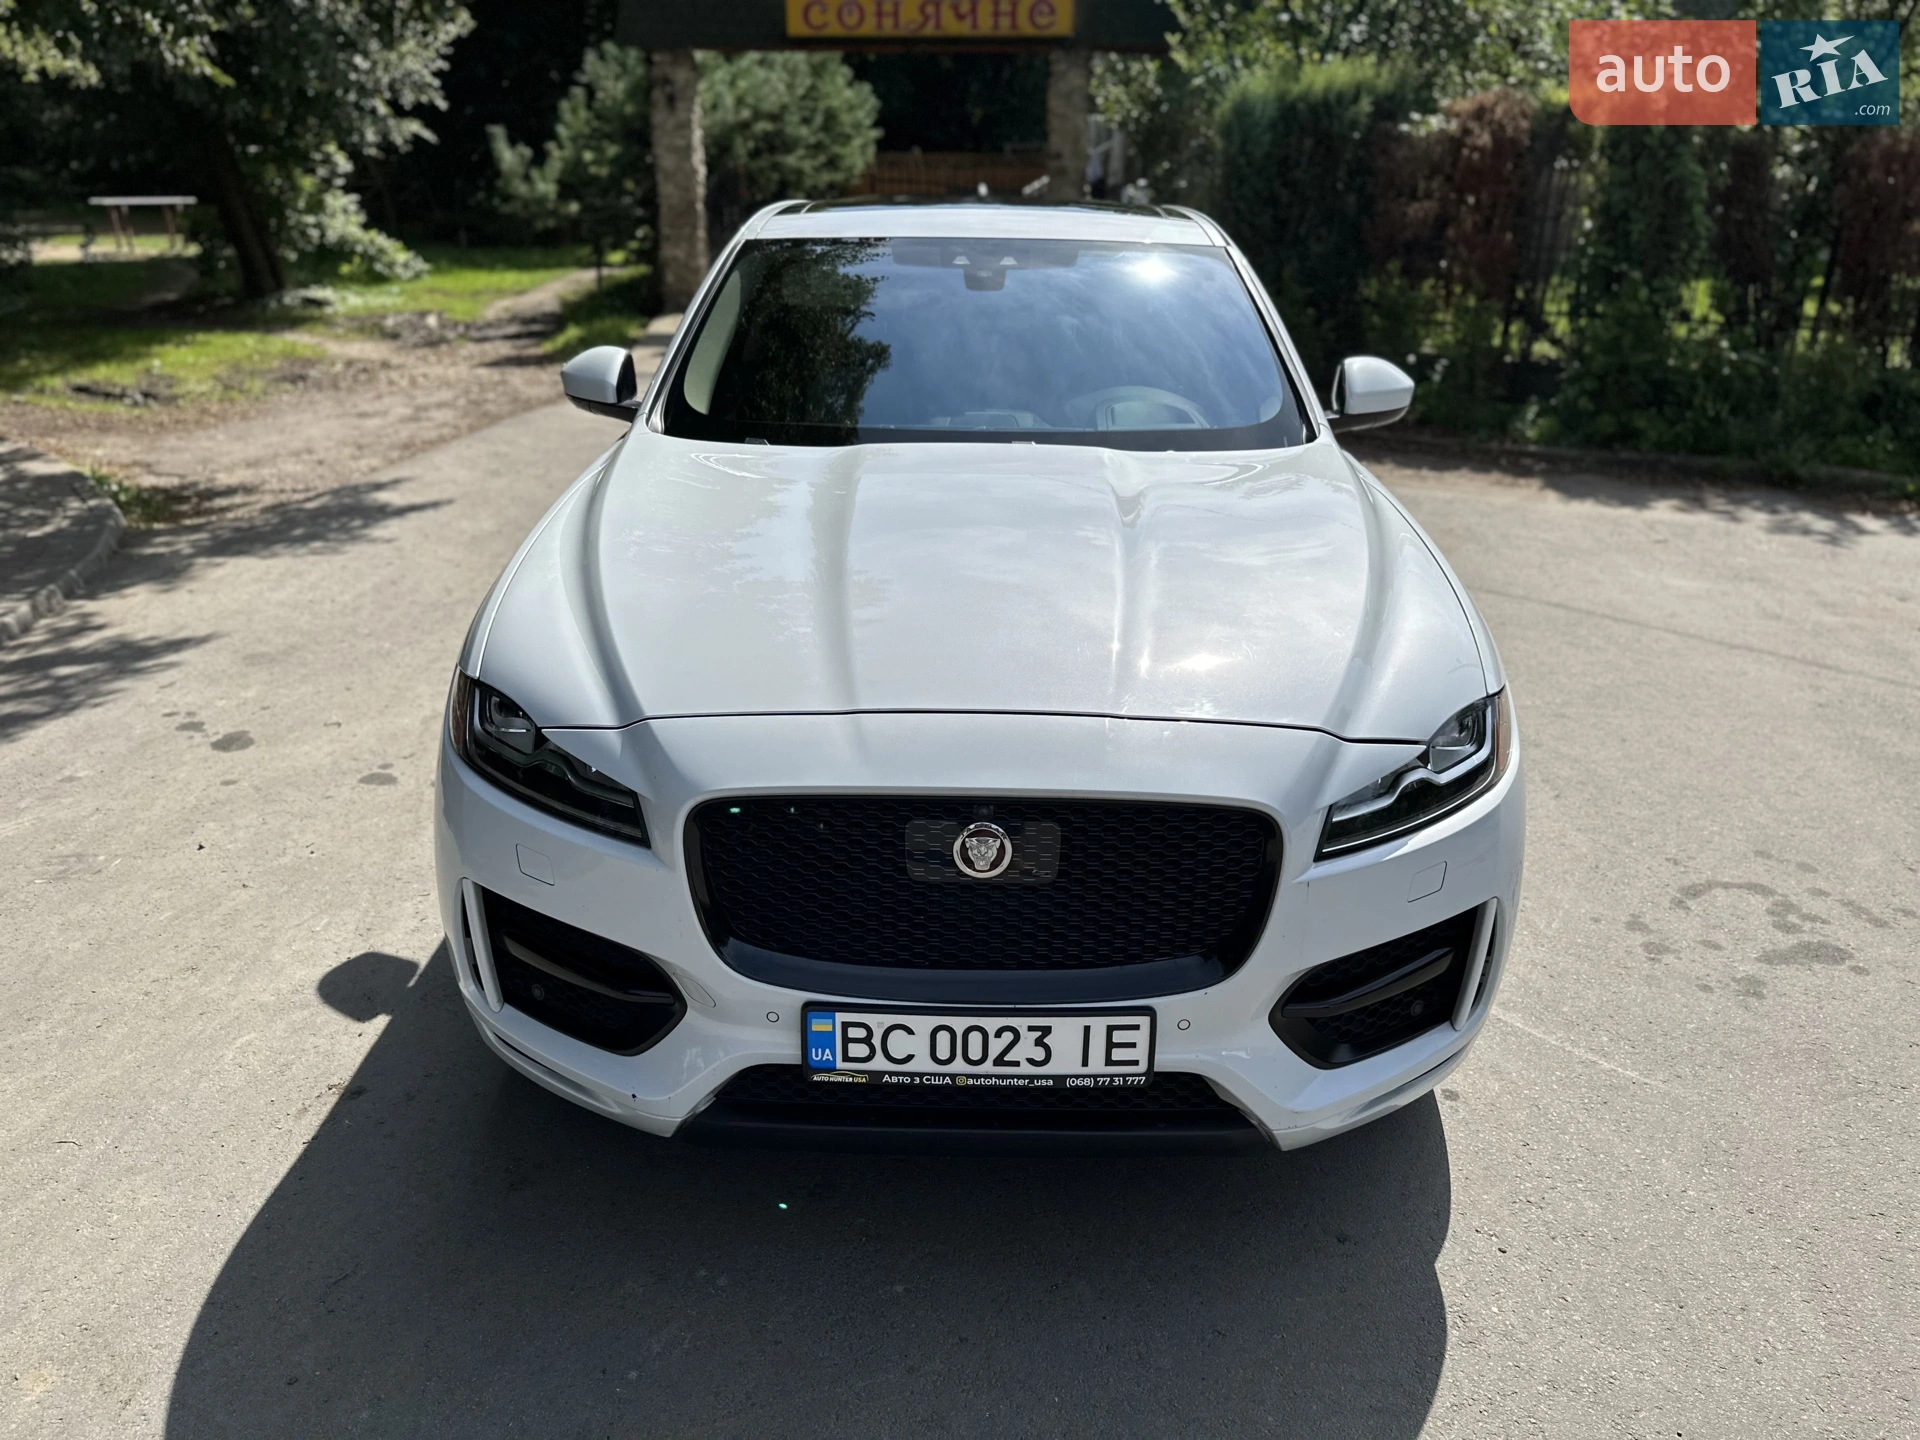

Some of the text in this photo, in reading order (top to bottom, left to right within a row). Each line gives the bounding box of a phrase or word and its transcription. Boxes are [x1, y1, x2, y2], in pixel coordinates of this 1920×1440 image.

[841, 1021, 1141, 1067] BC 0023 IE
[812, 1048, 833, 1061] UA
[882, 1074, 911, 1083] Авто
[922, 1076, 952, 1085] США
[1066, 1076, 1146, 1087] (068) 77 31 777
